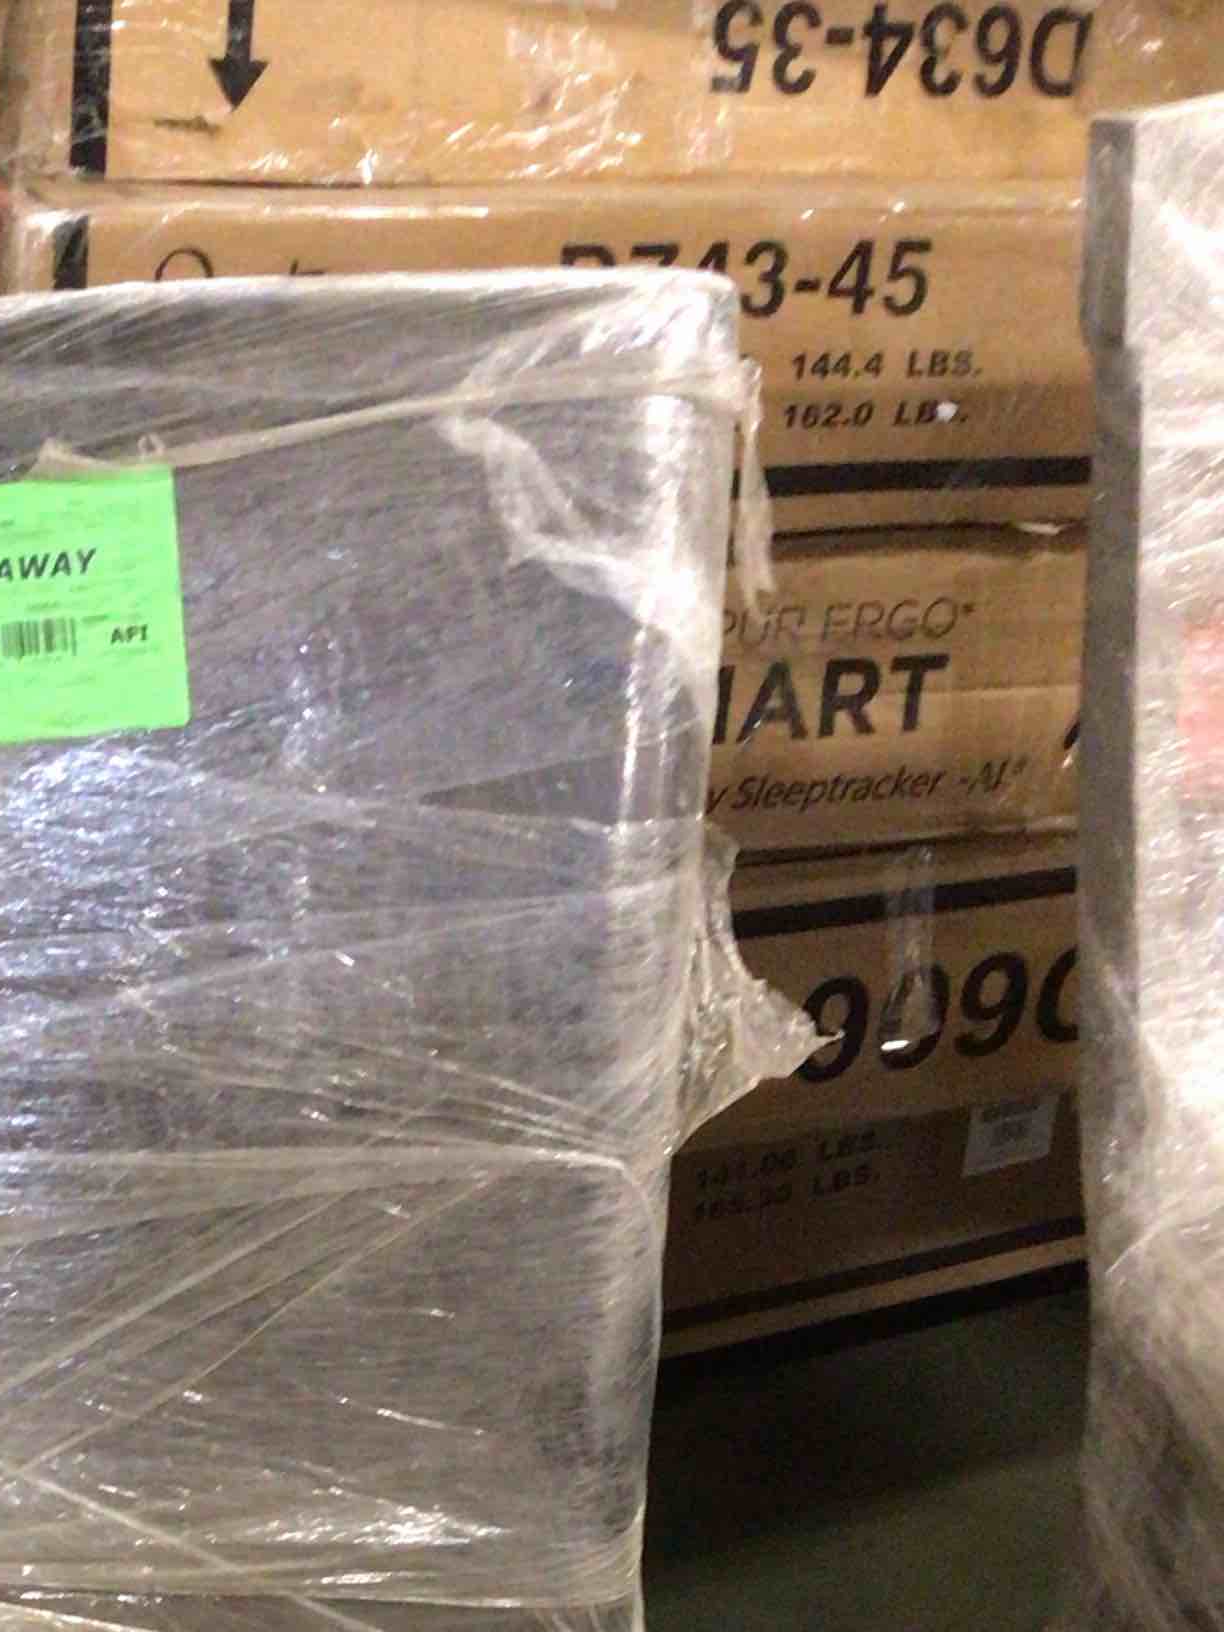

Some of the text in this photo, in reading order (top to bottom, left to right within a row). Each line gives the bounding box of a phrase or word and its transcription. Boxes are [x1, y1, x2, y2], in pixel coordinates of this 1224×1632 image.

[710, 0, 1094, 98] D634-35
[791, 351, 884, 381] 144.4
[783, 400, 969, 430] 162.0 LB.
[712, 653, 950, 746] ART
[730, 764, 946, 814] Sleeptracker
